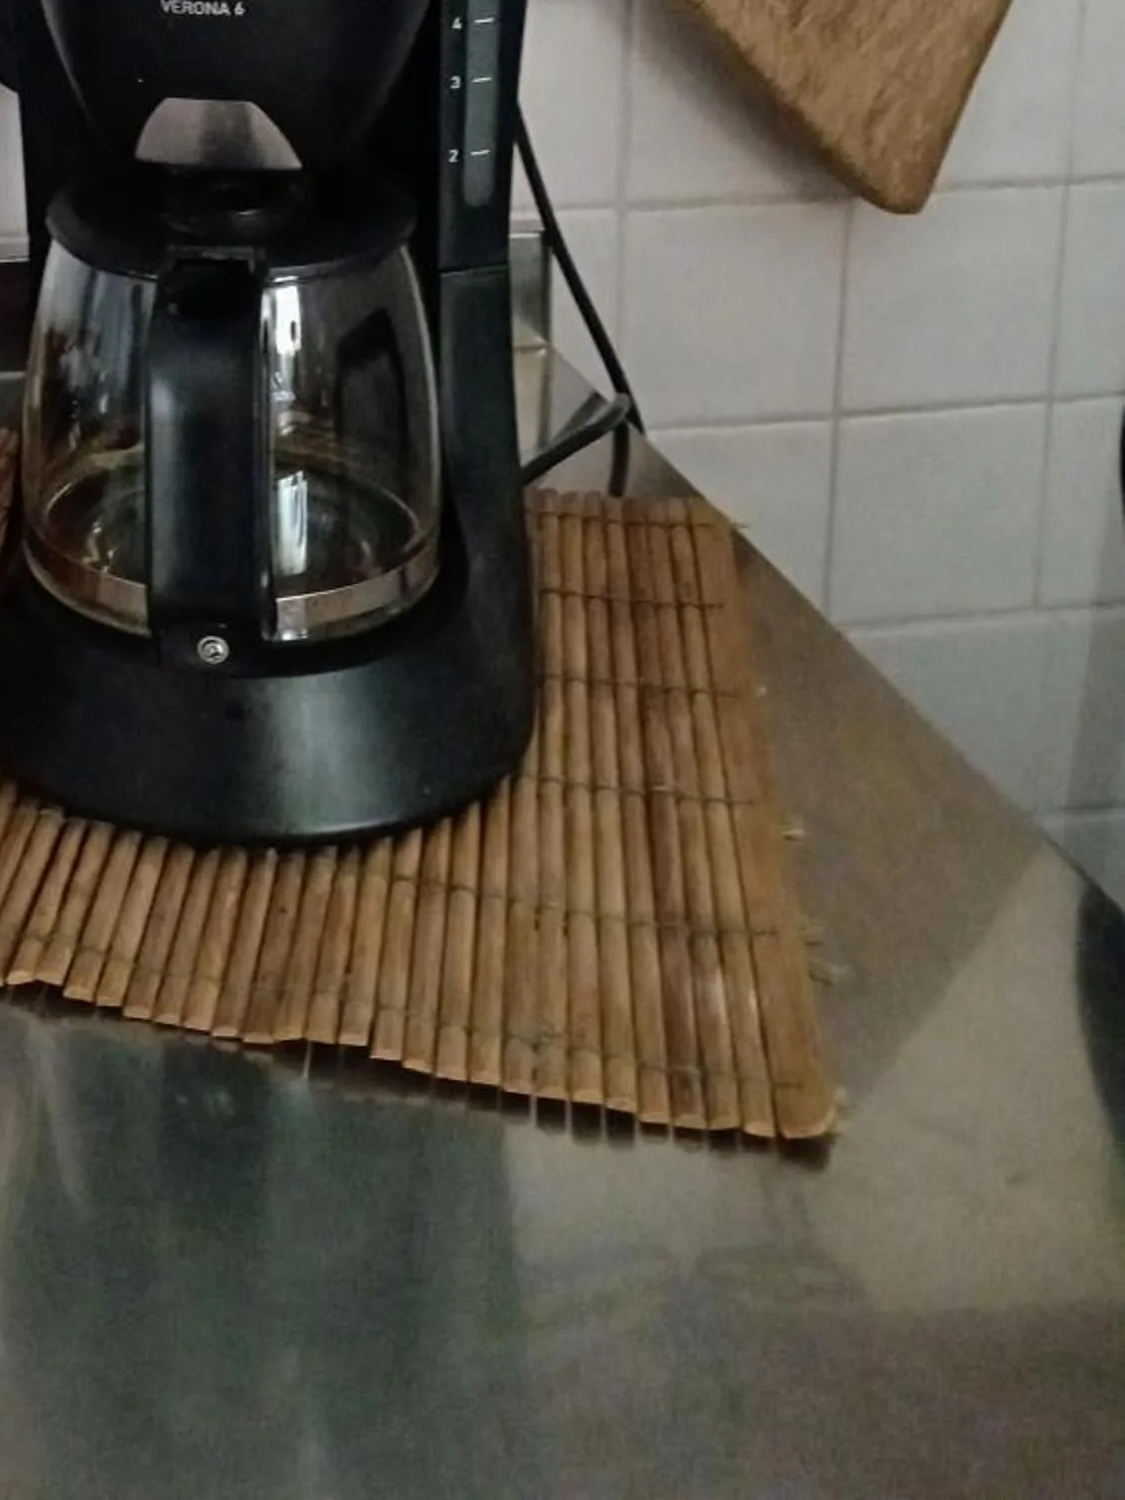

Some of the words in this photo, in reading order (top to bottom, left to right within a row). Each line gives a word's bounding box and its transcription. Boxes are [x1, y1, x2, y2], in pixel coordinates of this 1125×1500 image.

[234, 2, 245, 16] 6
[451, 17, 463, 29] 4
[450, 75, 462, 89] 3
[448, 149, 459, 163] 2
